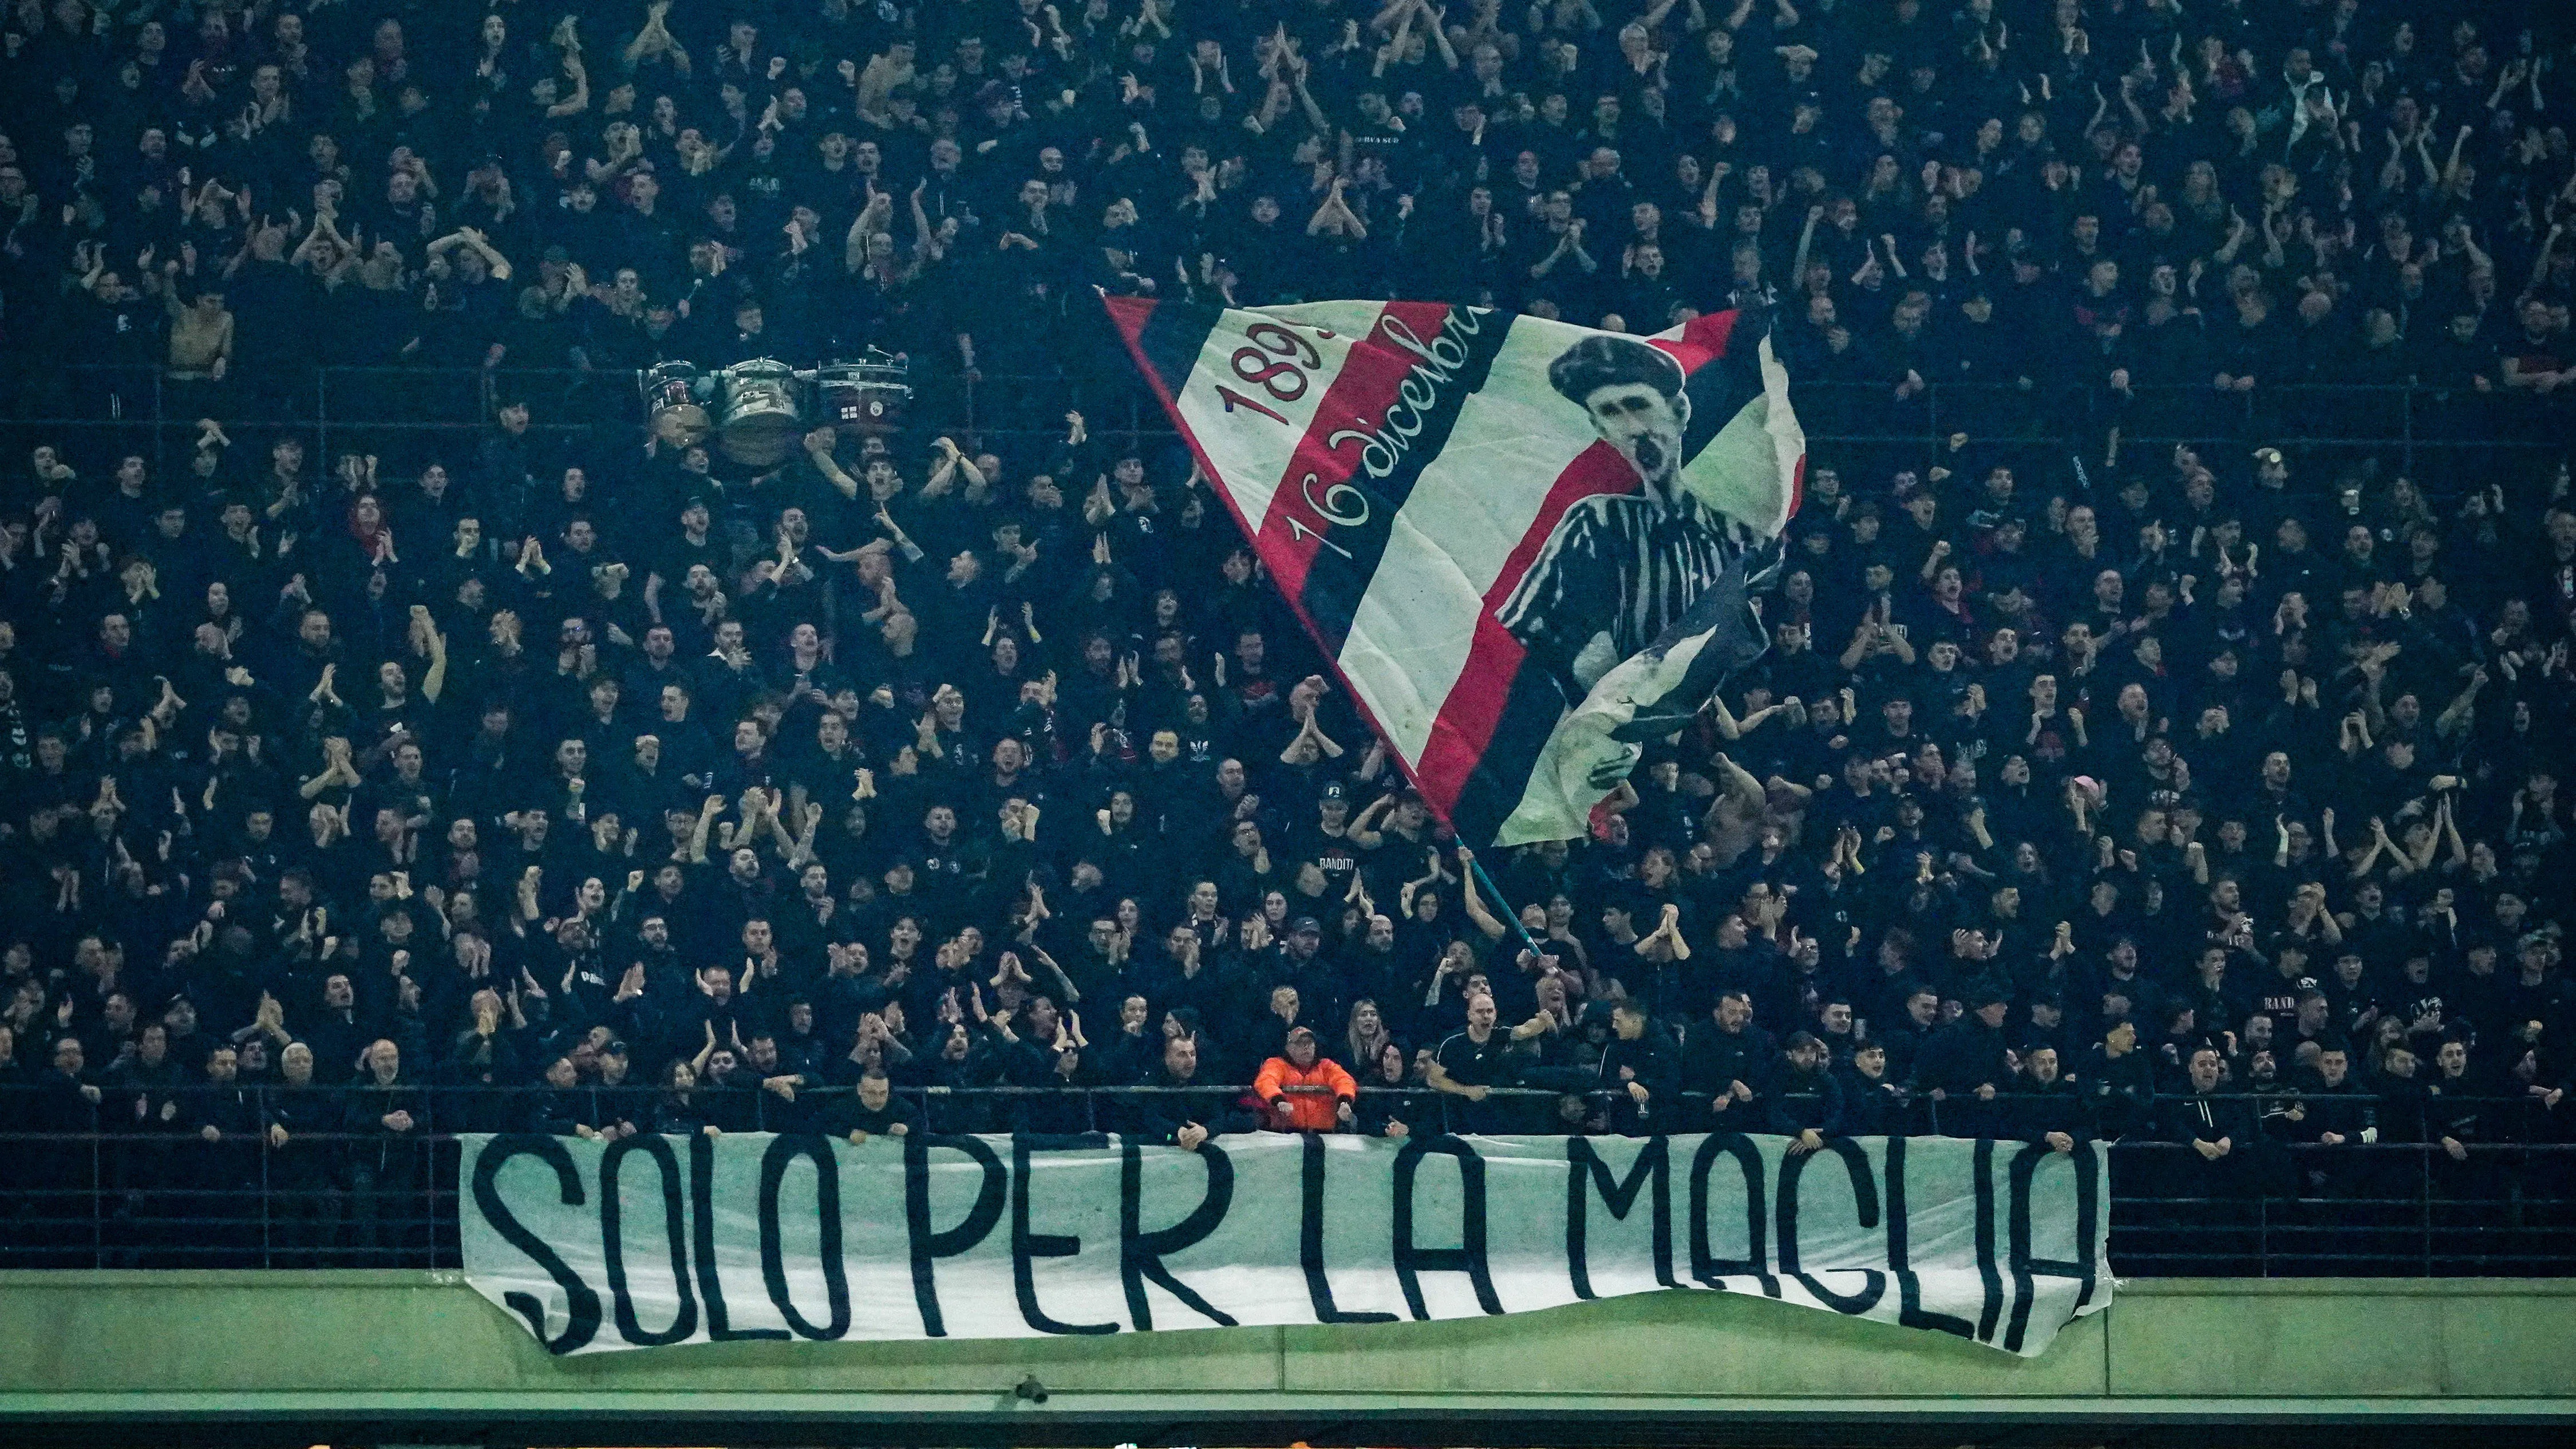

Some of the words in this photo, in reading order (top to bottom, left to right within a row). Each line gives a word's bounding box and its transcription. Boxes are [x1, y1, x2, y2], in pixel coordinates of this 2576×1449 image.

[1214, 319, 1336, 425] 189
[1286, 473, 1369, 559] 16
[1319, 858, 1354, 870] BANDITI
[472, 1132, 852, 1355] SOLO
[904, 1132, 1240, 1337] PER
[1300, 1132, 1505, 1324] LA
[1566, 1132, 2099, 1353] MAGLIA
